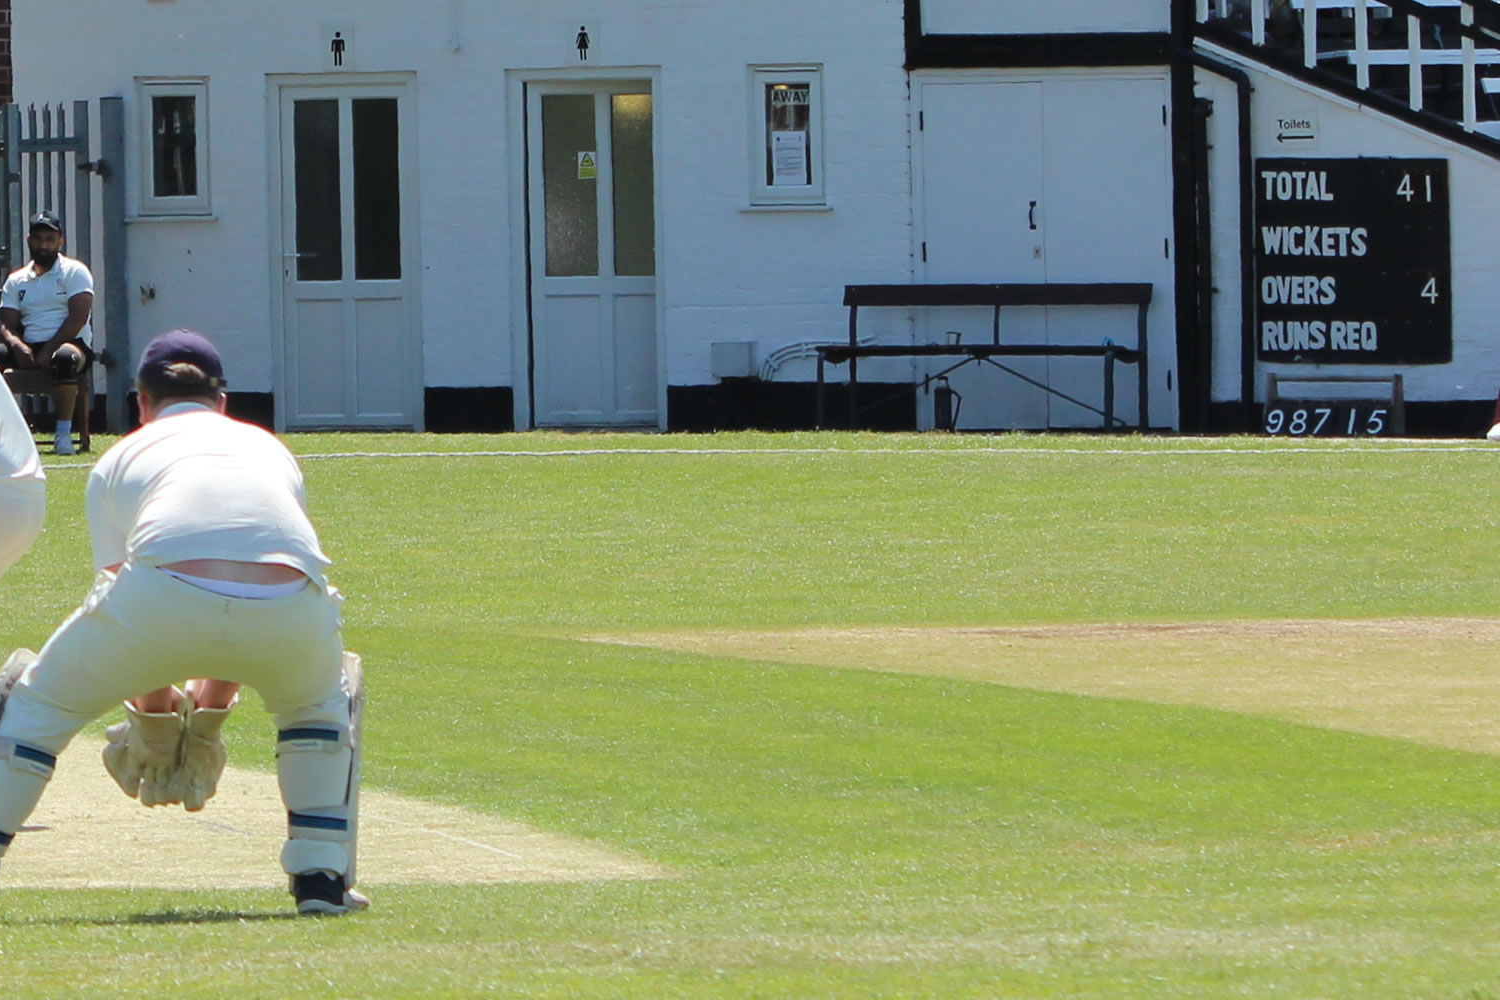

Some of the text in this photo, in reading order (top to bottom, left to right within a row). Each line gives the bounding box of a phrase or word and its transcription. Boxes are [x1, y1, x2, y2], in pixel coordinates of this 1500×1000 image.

[773, 90, 809, 103] AWAY
[1277, 119, 1311, 129] Toilets
[1261, 171, 1334, 201] TOTAL
[1261, 225, 1368, 257] WICKETS
[1261, 276, 1439, 305] OVERS 4
[1262, 320, 1378, 351] RUNS REQ
